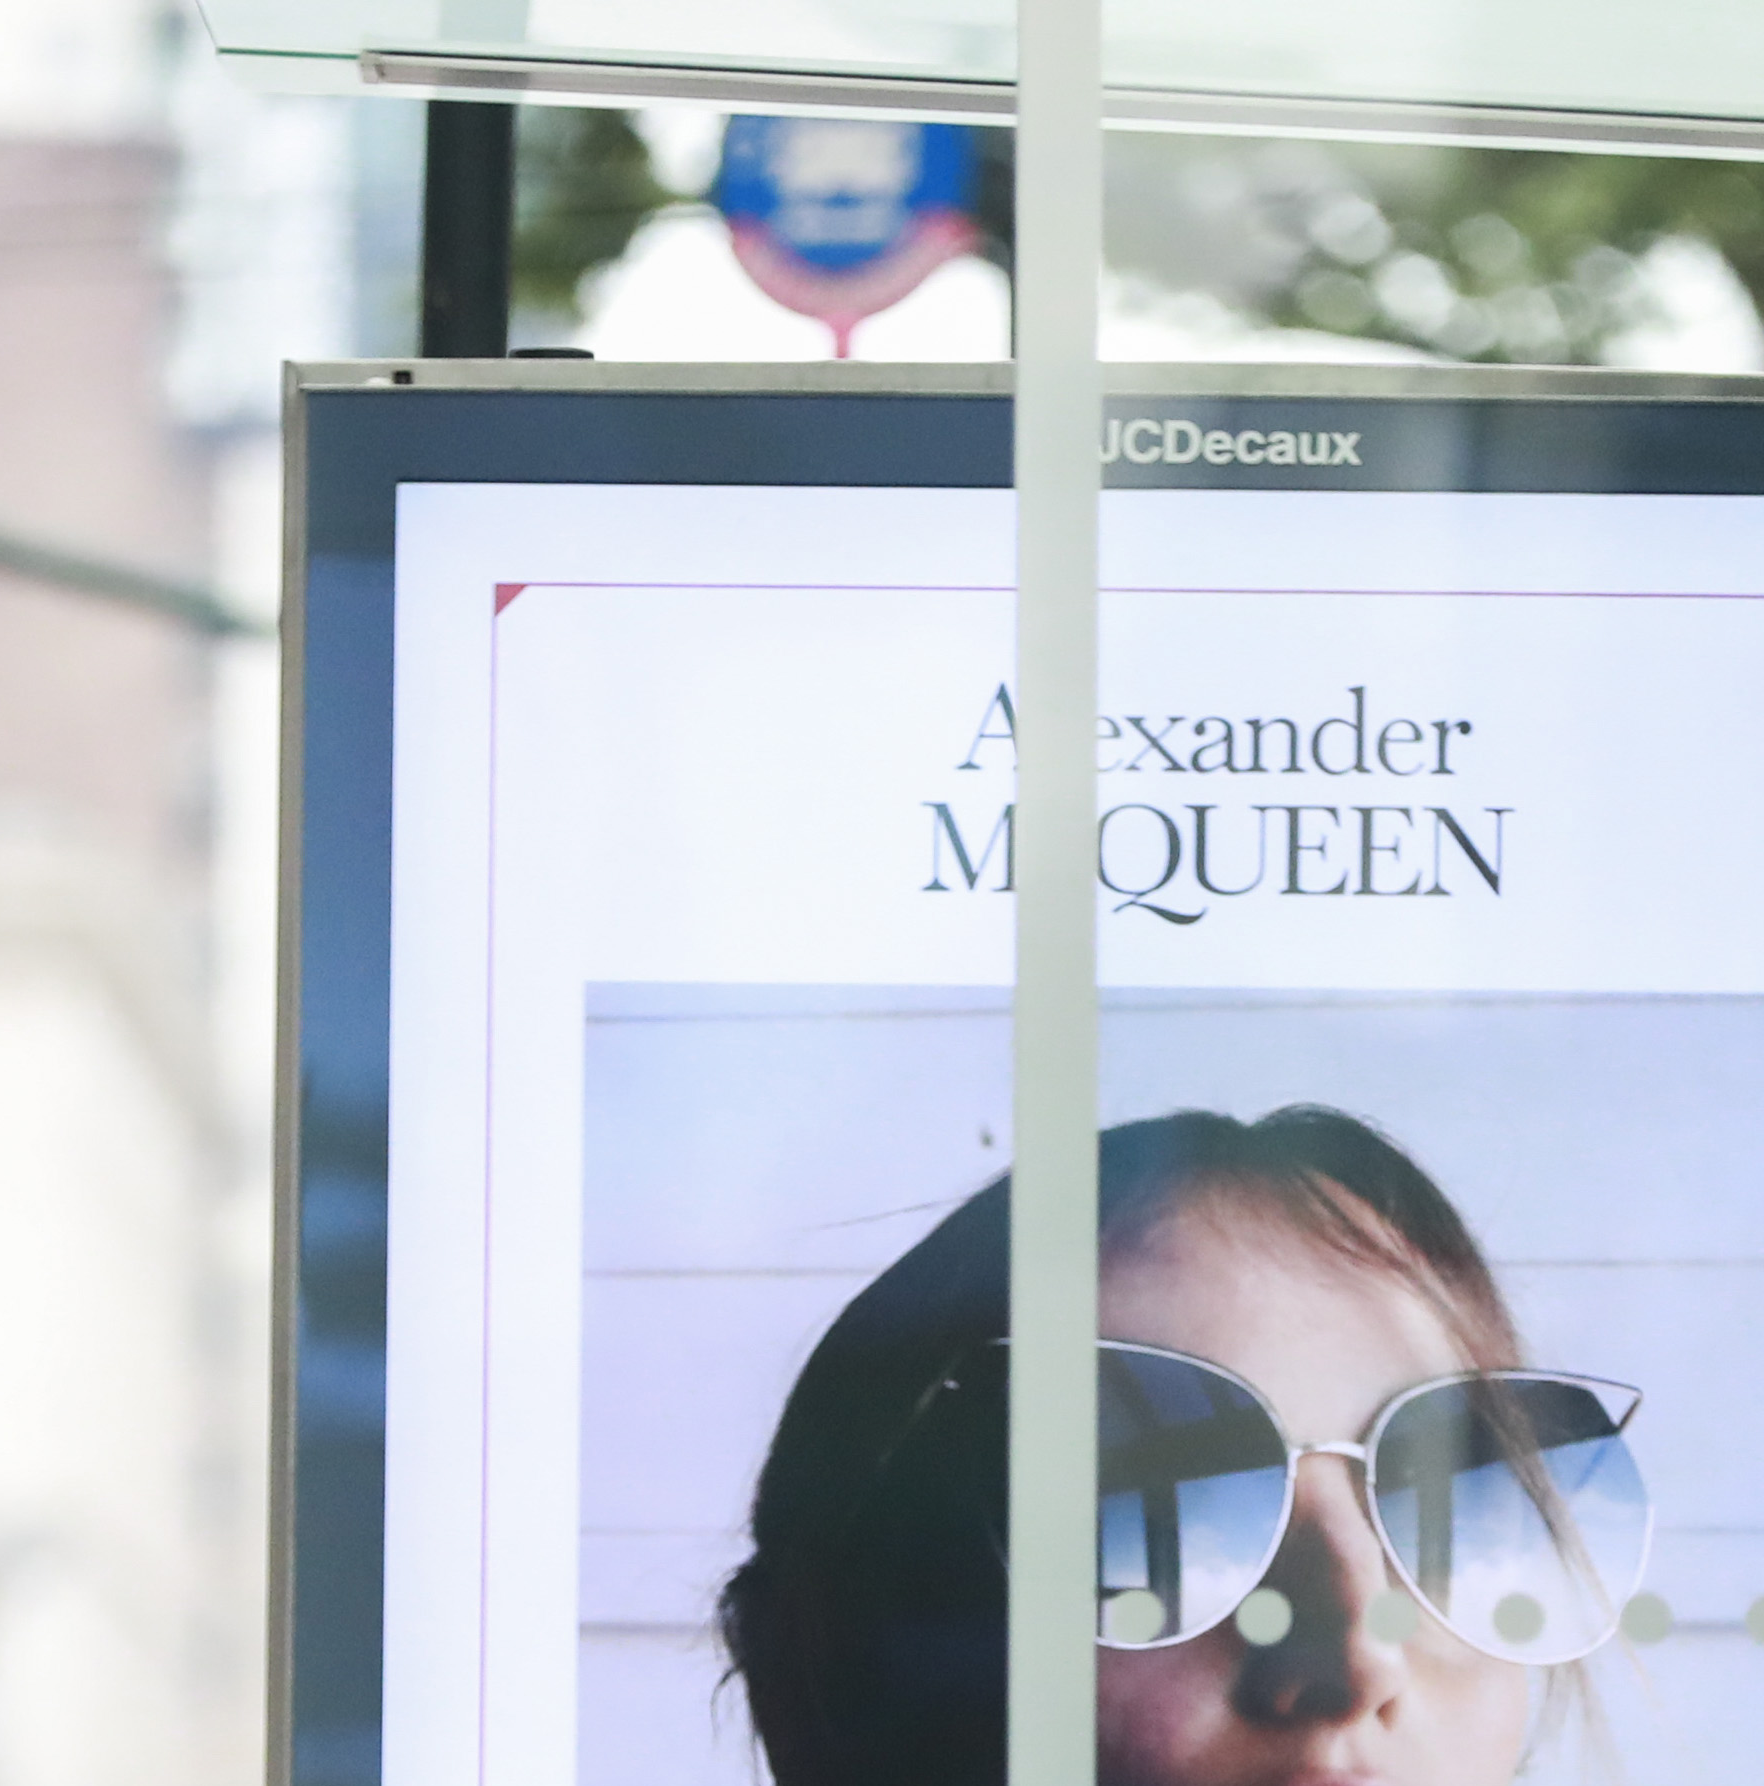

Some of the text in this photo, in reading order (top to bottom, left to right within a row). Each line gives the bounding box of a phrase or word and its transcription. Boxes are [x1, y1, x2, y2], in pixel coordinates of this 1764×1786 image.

[1097, 417, 1364, 466] JCDecaux
[954, 681, 1473, 776] Aexander
[919, 802, 1517, 926] MQUEEN
